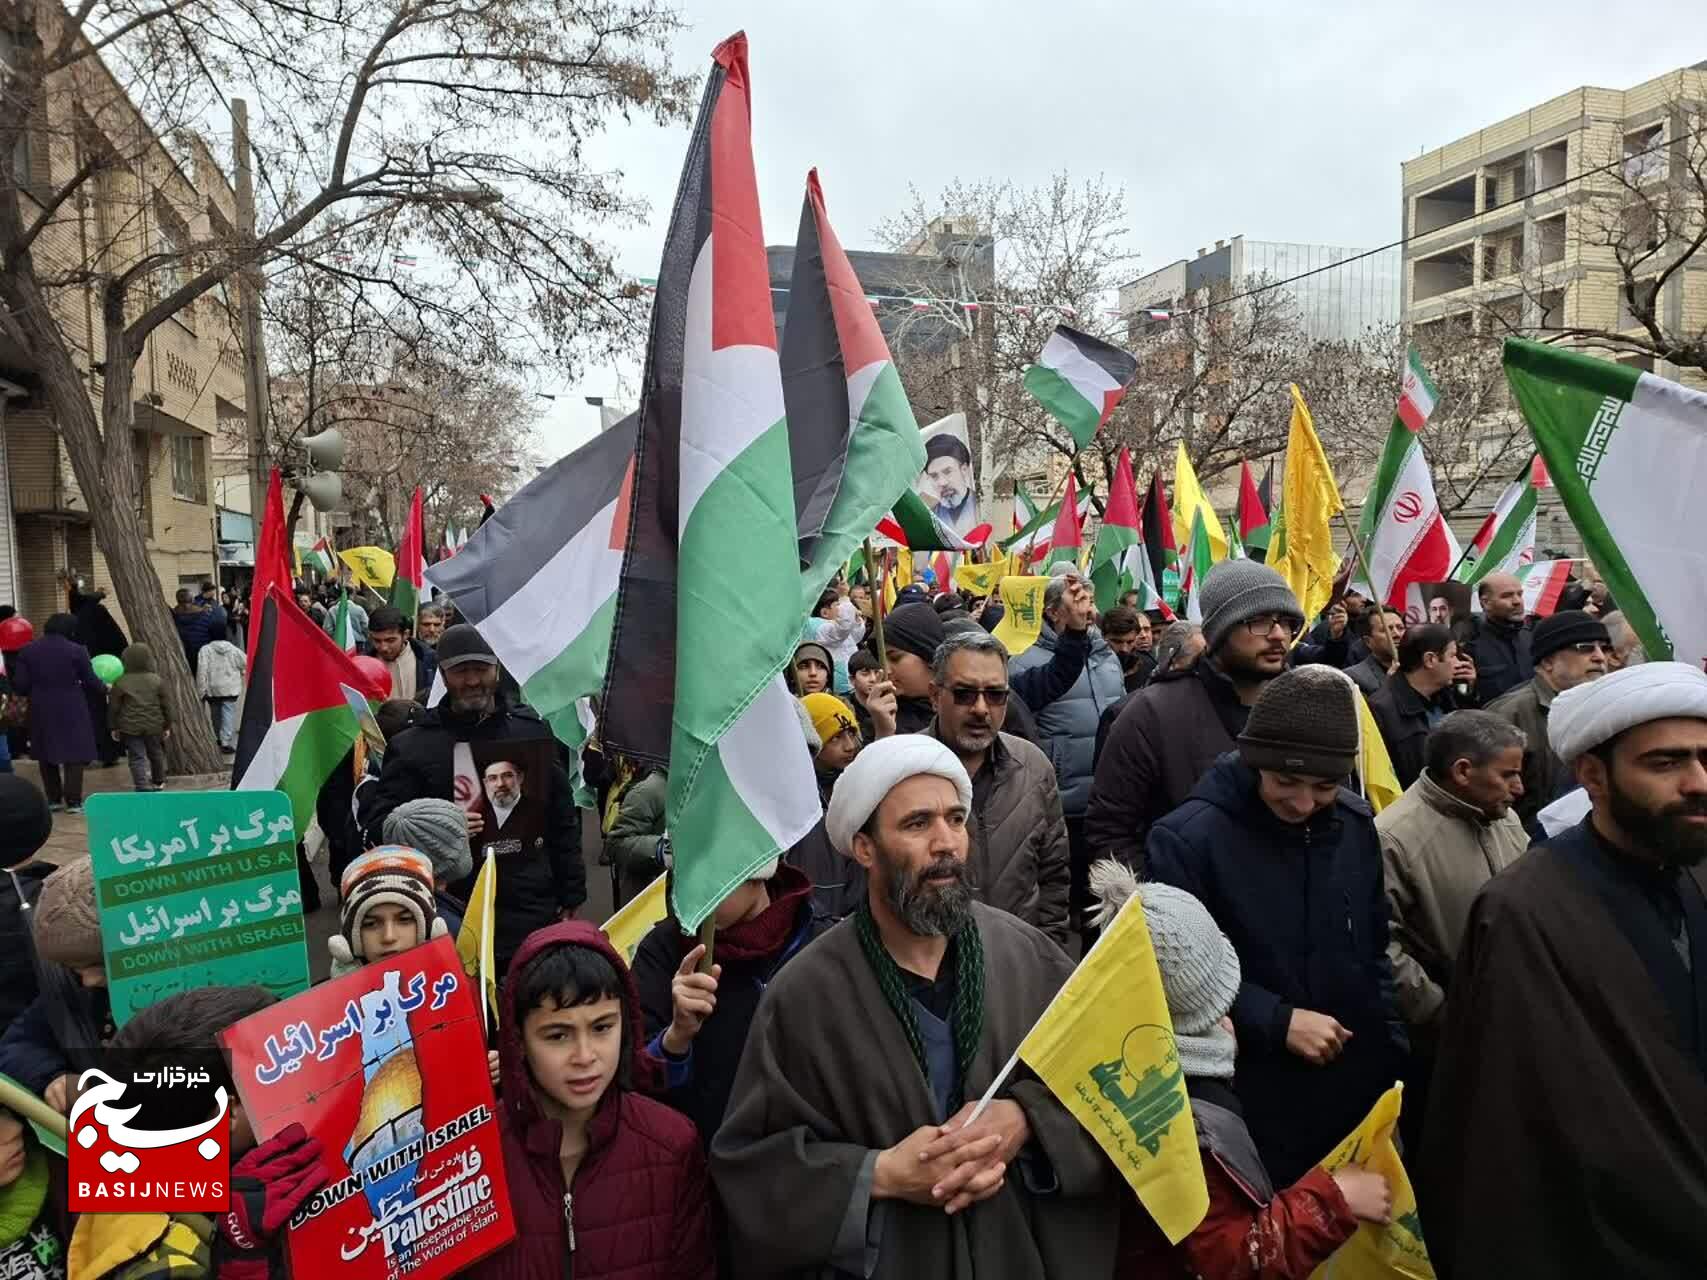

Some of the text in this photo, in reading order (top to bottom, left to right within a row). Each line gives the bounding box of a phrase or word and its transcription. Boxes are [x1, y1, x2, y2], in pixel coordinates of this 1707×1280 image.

[110, 808, 294, 867] مرگ بر آمریکا
[114, 873, 177, 898] DOWN
[182, 863, 233, 883] WITH
[119, 883, 301, 945] مرگ بر اسرائیل
[121, 922, 304, 970] DOWN WITH ISRAEL
[256, 971, 457, 1084] مرگ بر اسرائیل
[289, 1104, 492, 1230] DOWN WITH ISRAEL
[341, 1144, 482, 1261] فلسطین
[381, 1174, 492, 1259] Palestine
[399, 1249, 411, 1262] an
[413, 1213, 472, 1254] Inseparable
[473, 1200, 495, 1217] Part
[387, 1267, 399, 1280] of
[401, 1258, 421, 1274] The
[422, 1235, 455, 1261] World
[456, 1226, 467, 1242] of
